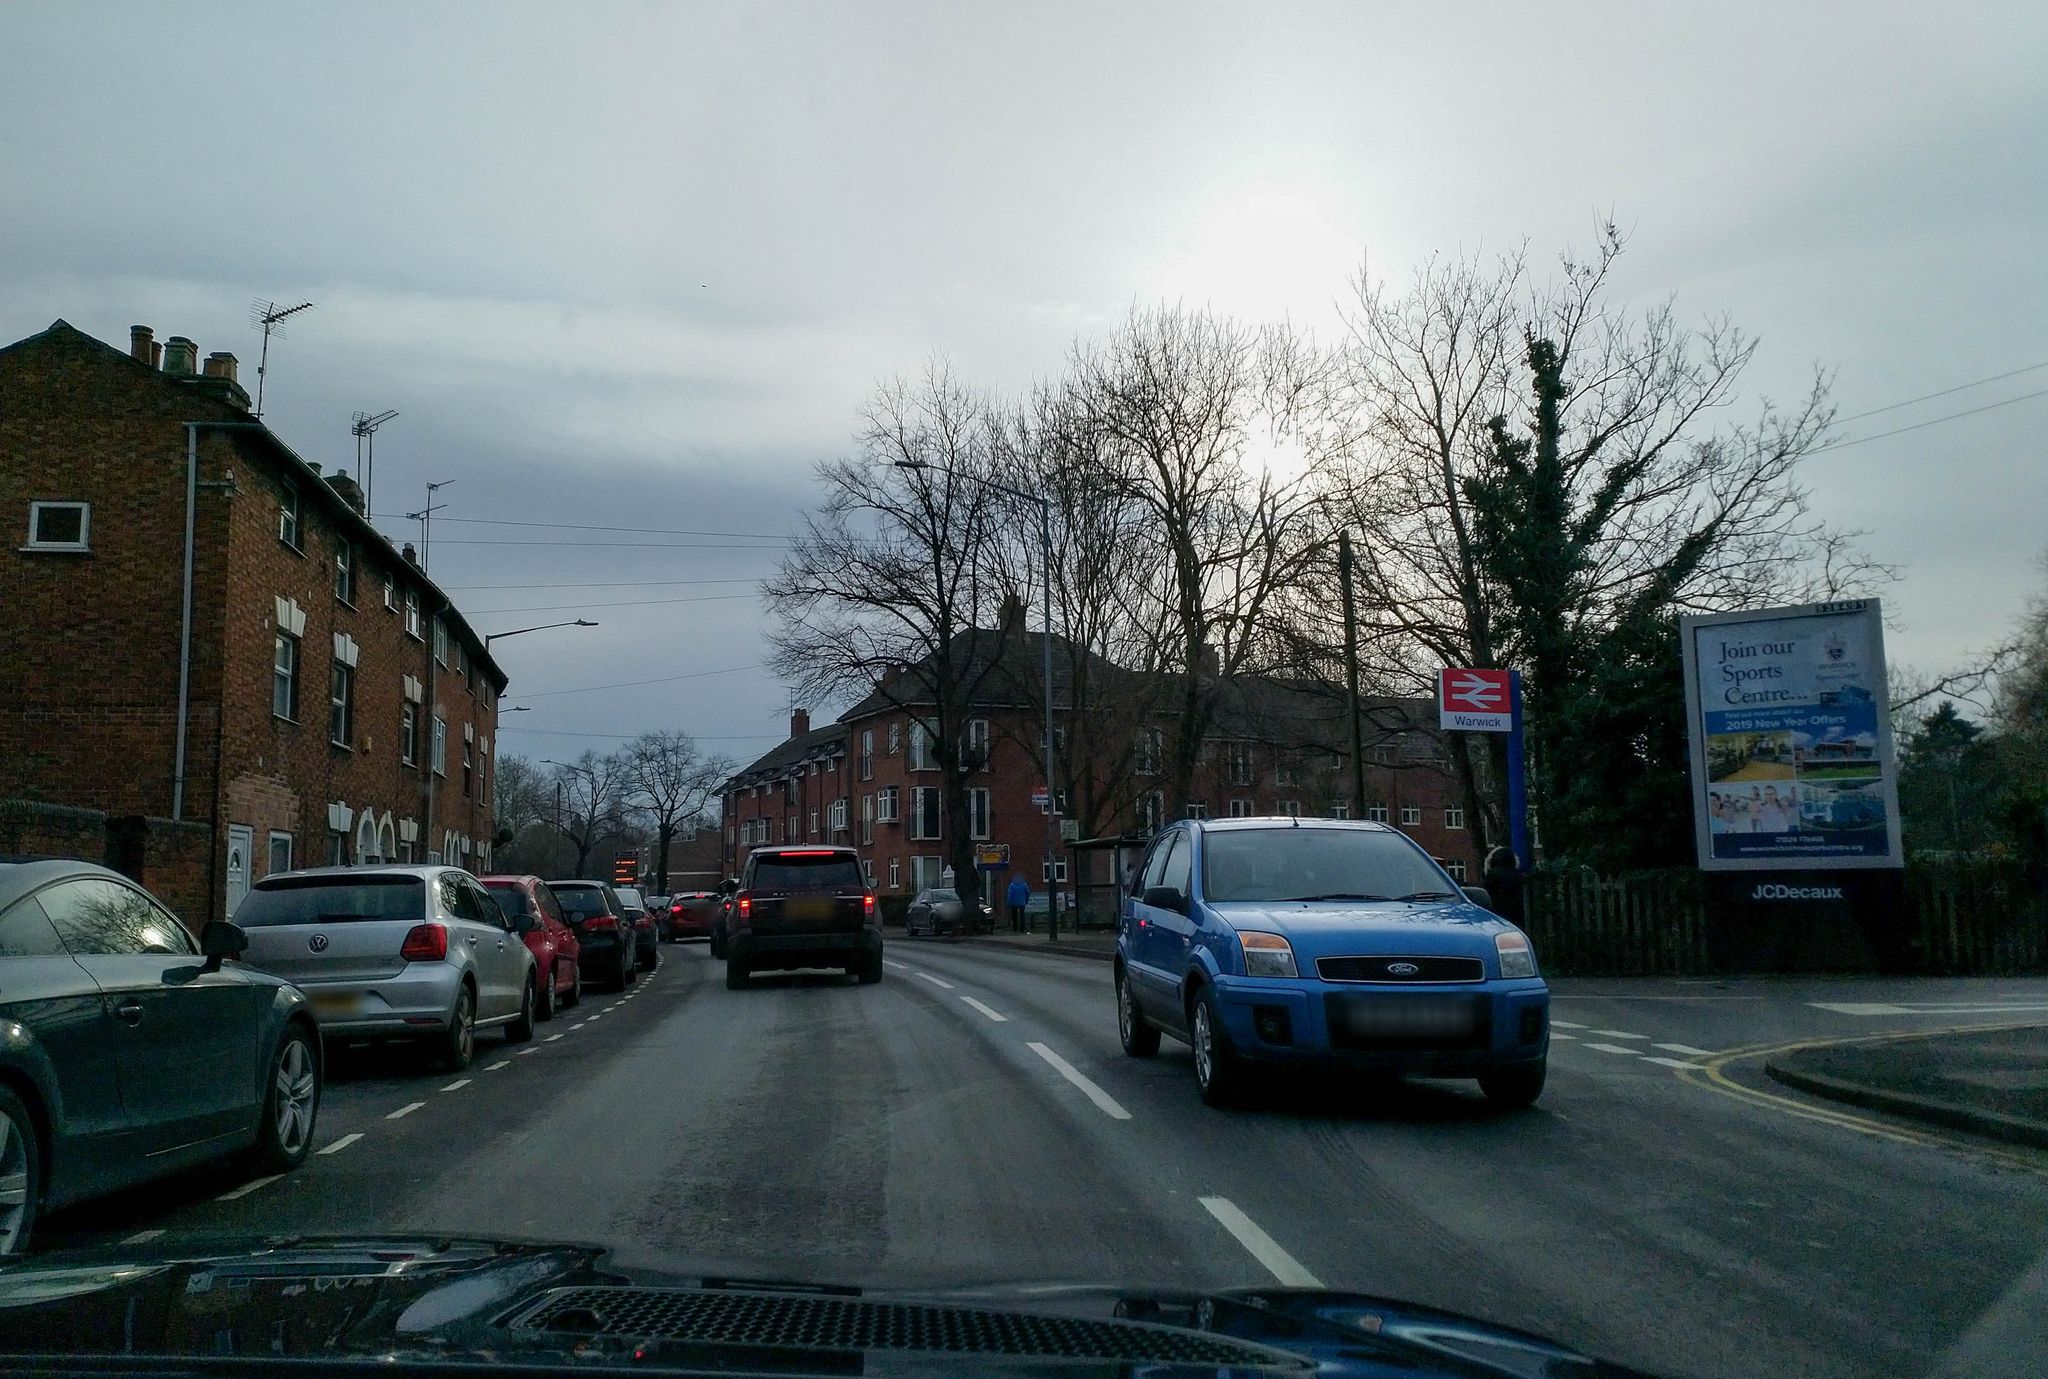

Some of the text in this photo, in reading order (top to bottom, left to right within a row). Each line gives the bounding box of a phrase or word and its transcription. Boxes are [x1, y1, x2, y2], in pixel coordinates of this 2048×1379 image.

[1719, 642, 1795, 664] Join our
[1723, 664, 1782, 686] Sports
[1725, 687, 1808, 705] Centre...
[1454, 715, 1501, 727] Warwick
[1726, 715, 1847, 730] 2019 New Year Offers
[1752, 884, 1843, 899] JCDecaux
